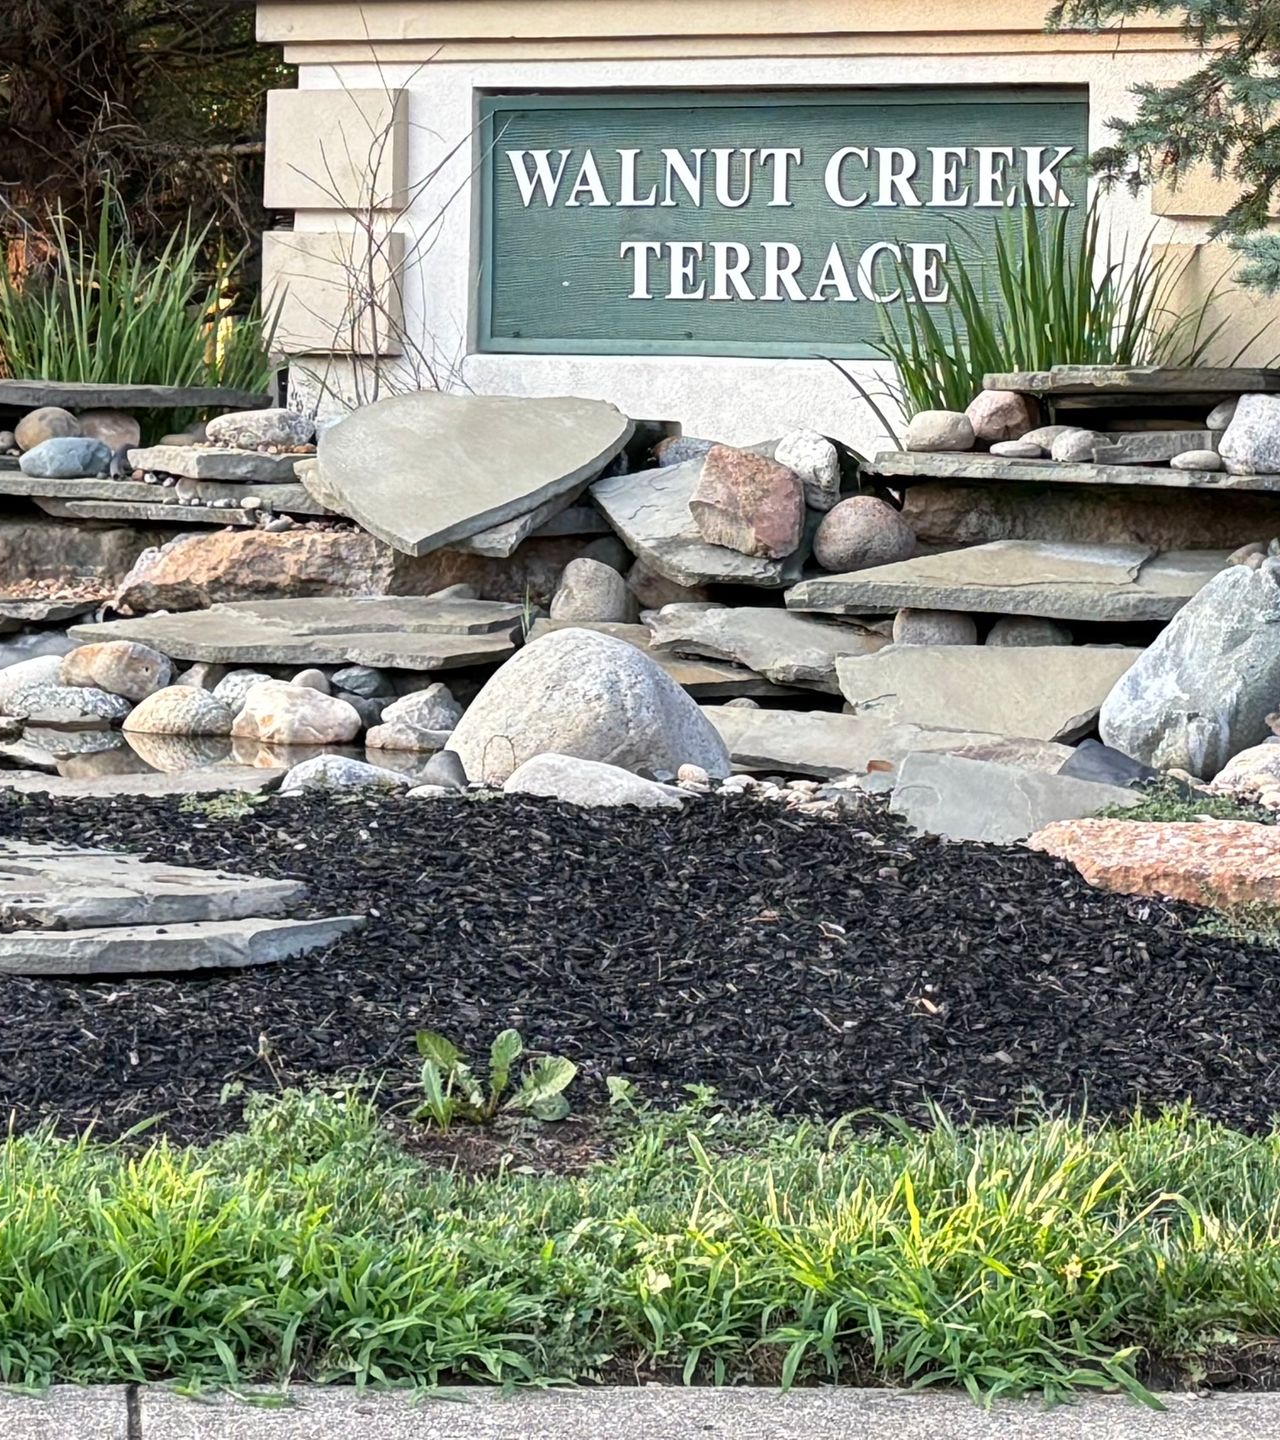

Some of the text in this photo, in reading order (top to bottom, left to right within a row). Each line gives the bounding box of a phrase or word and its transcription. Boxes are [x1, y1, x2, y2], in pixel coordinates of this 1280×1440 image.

[505, 145, 1076, 208] WALNUT CREEK
[619, 240, 950, 304] TERRACE
